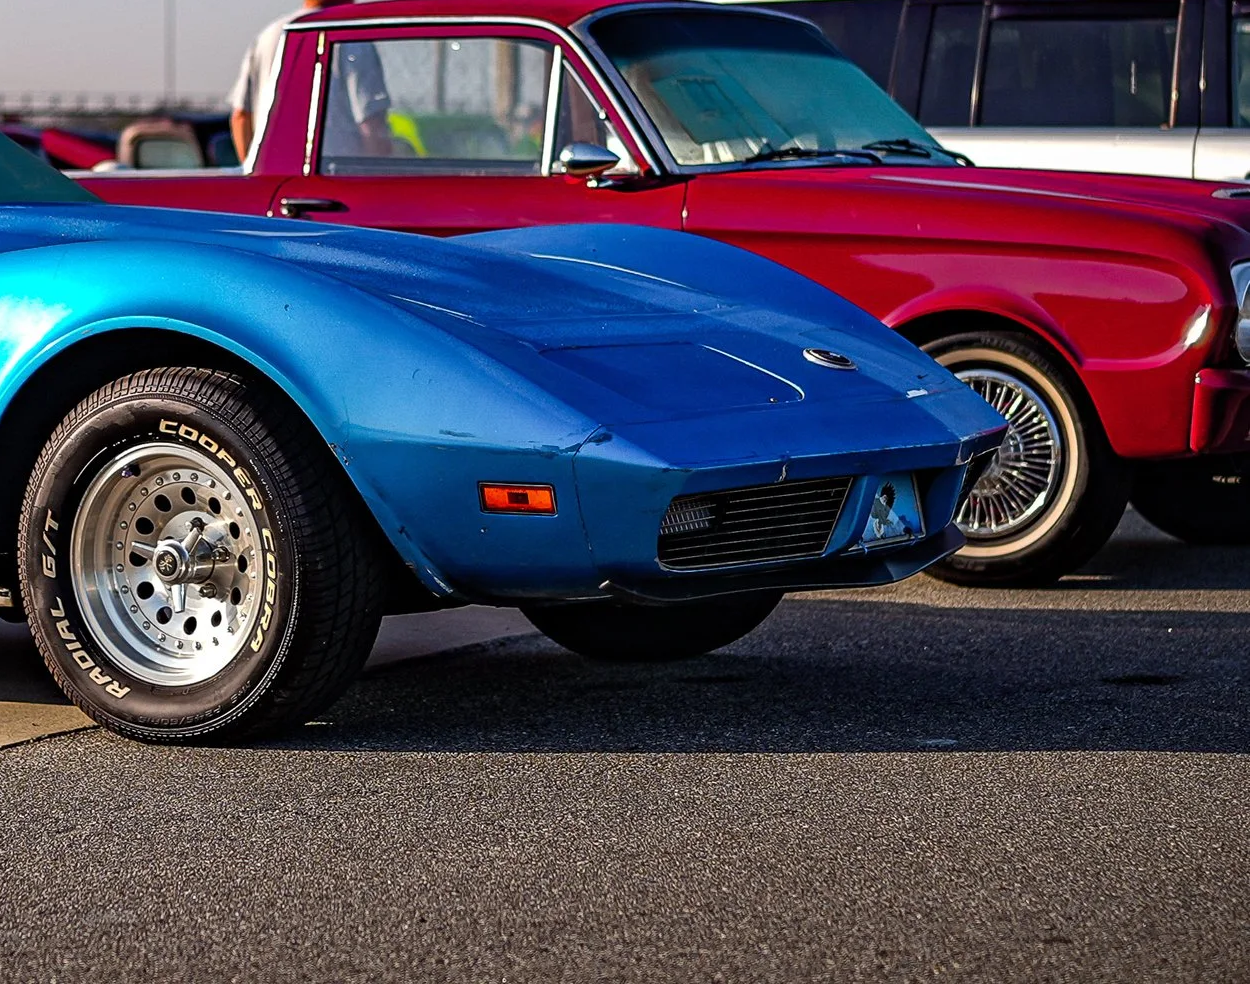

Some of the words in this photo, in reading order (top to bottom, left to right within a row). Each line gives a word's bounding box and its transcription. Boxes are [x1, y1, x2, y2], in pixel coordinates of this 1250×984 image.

[42, 509, 62, 578] G/T
[158, 418, 263, 511] COOPER
[249, 527, 278, 653] COBRA
[50, 596, 134, 700] RADIAL
